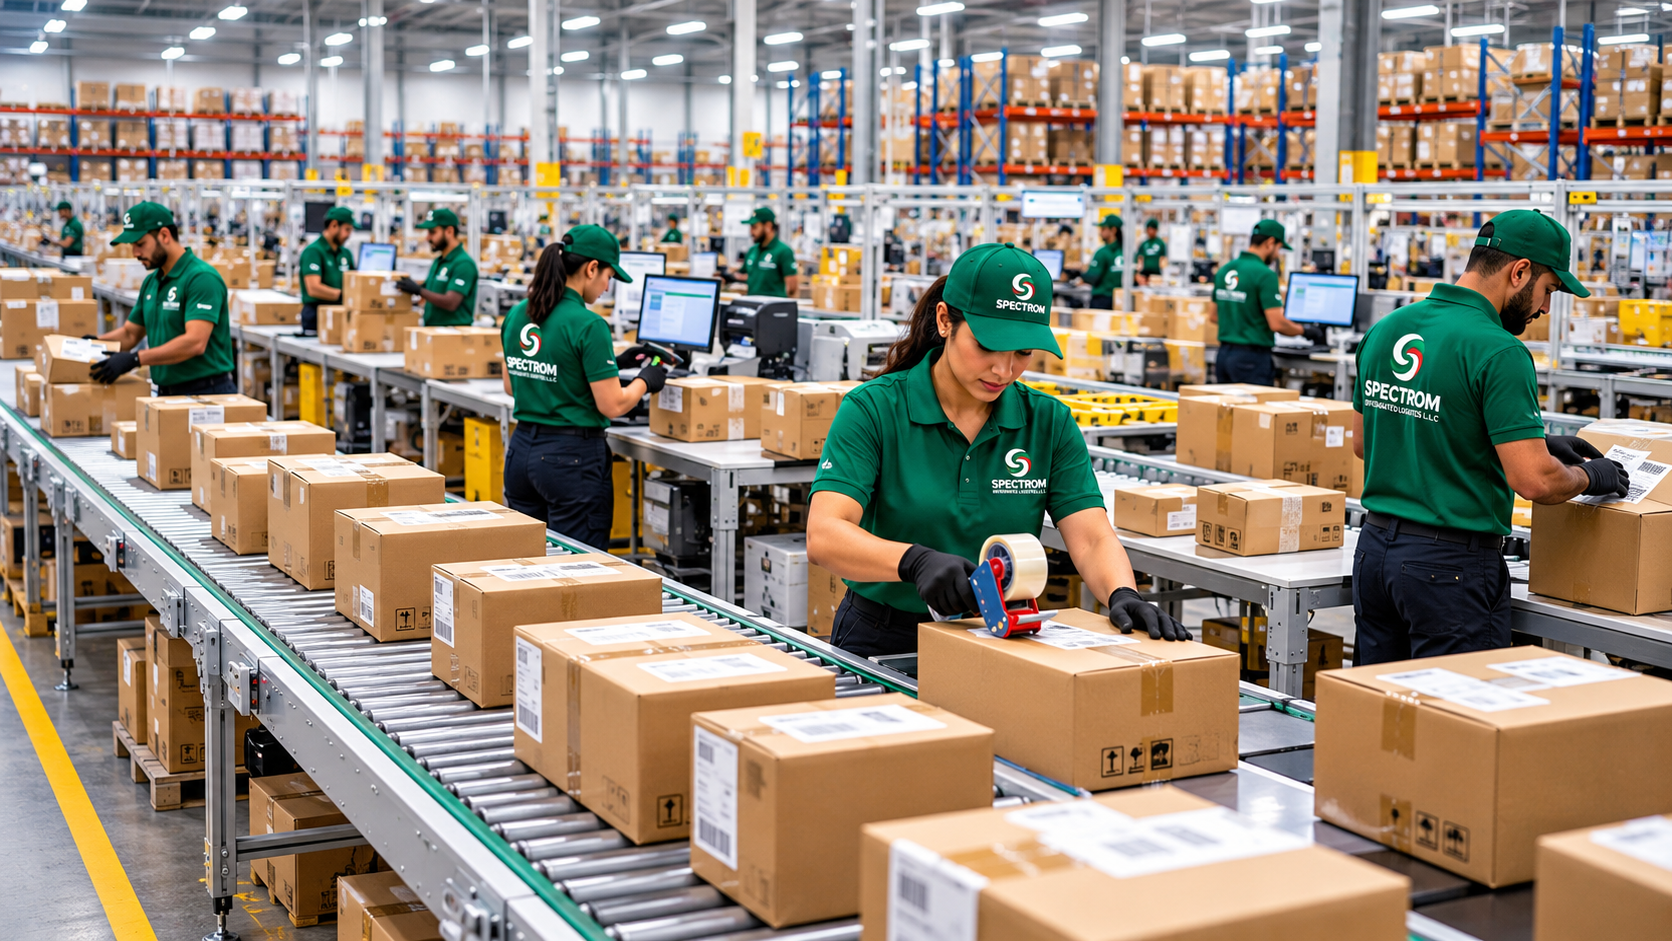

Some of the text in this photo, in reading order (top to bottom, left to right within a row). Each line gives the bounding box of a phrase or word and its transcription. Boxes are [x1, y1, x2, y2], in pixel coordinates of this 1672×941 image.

[507, 356, 557, 376] SPECTROM
[1364, 380, 1441, 412] SPECTROM
[991, 479, 1047, 489] SPECTROM
